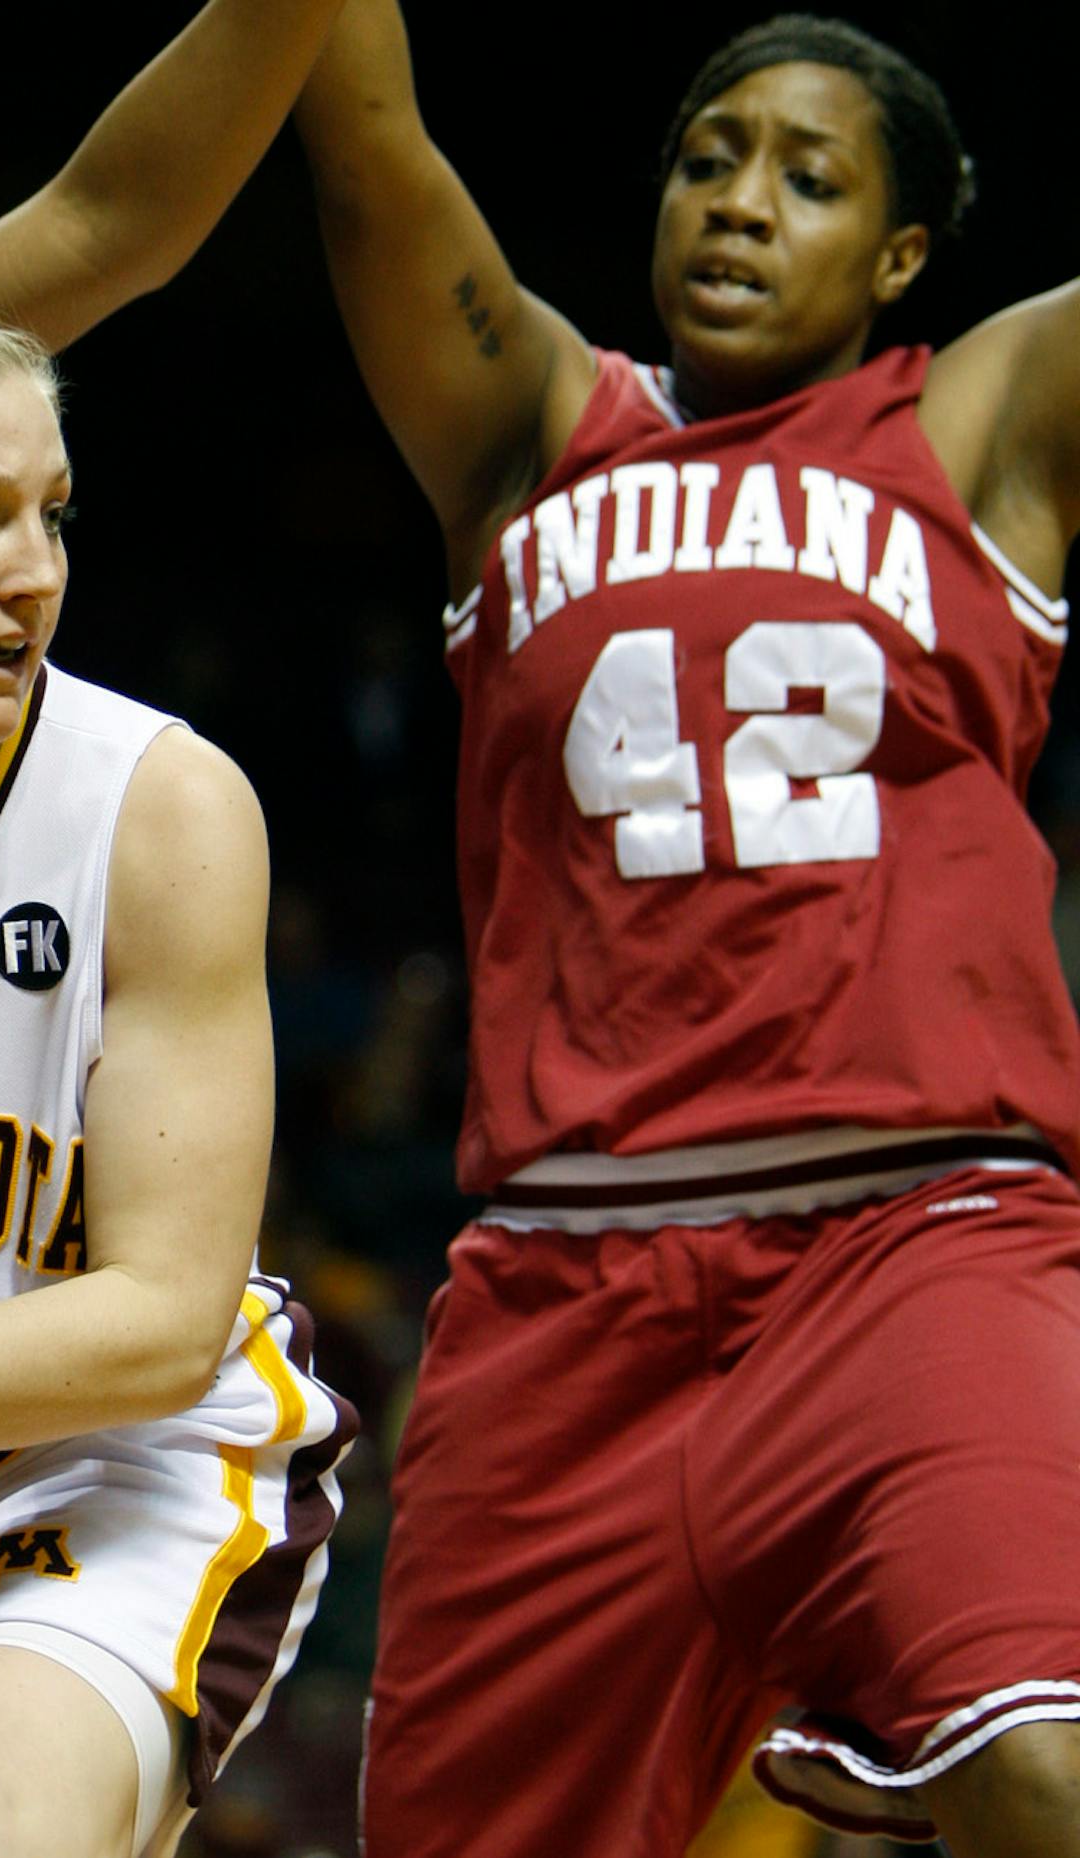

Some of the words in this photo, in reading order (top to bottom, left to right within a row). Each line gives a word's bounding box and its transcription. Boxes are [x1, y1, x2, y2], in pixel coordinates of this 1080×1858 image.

[500, 461, 937, 654] INDIANA
[563, 622, 886, 879] 42
[2, 919, 62, 974] FK
